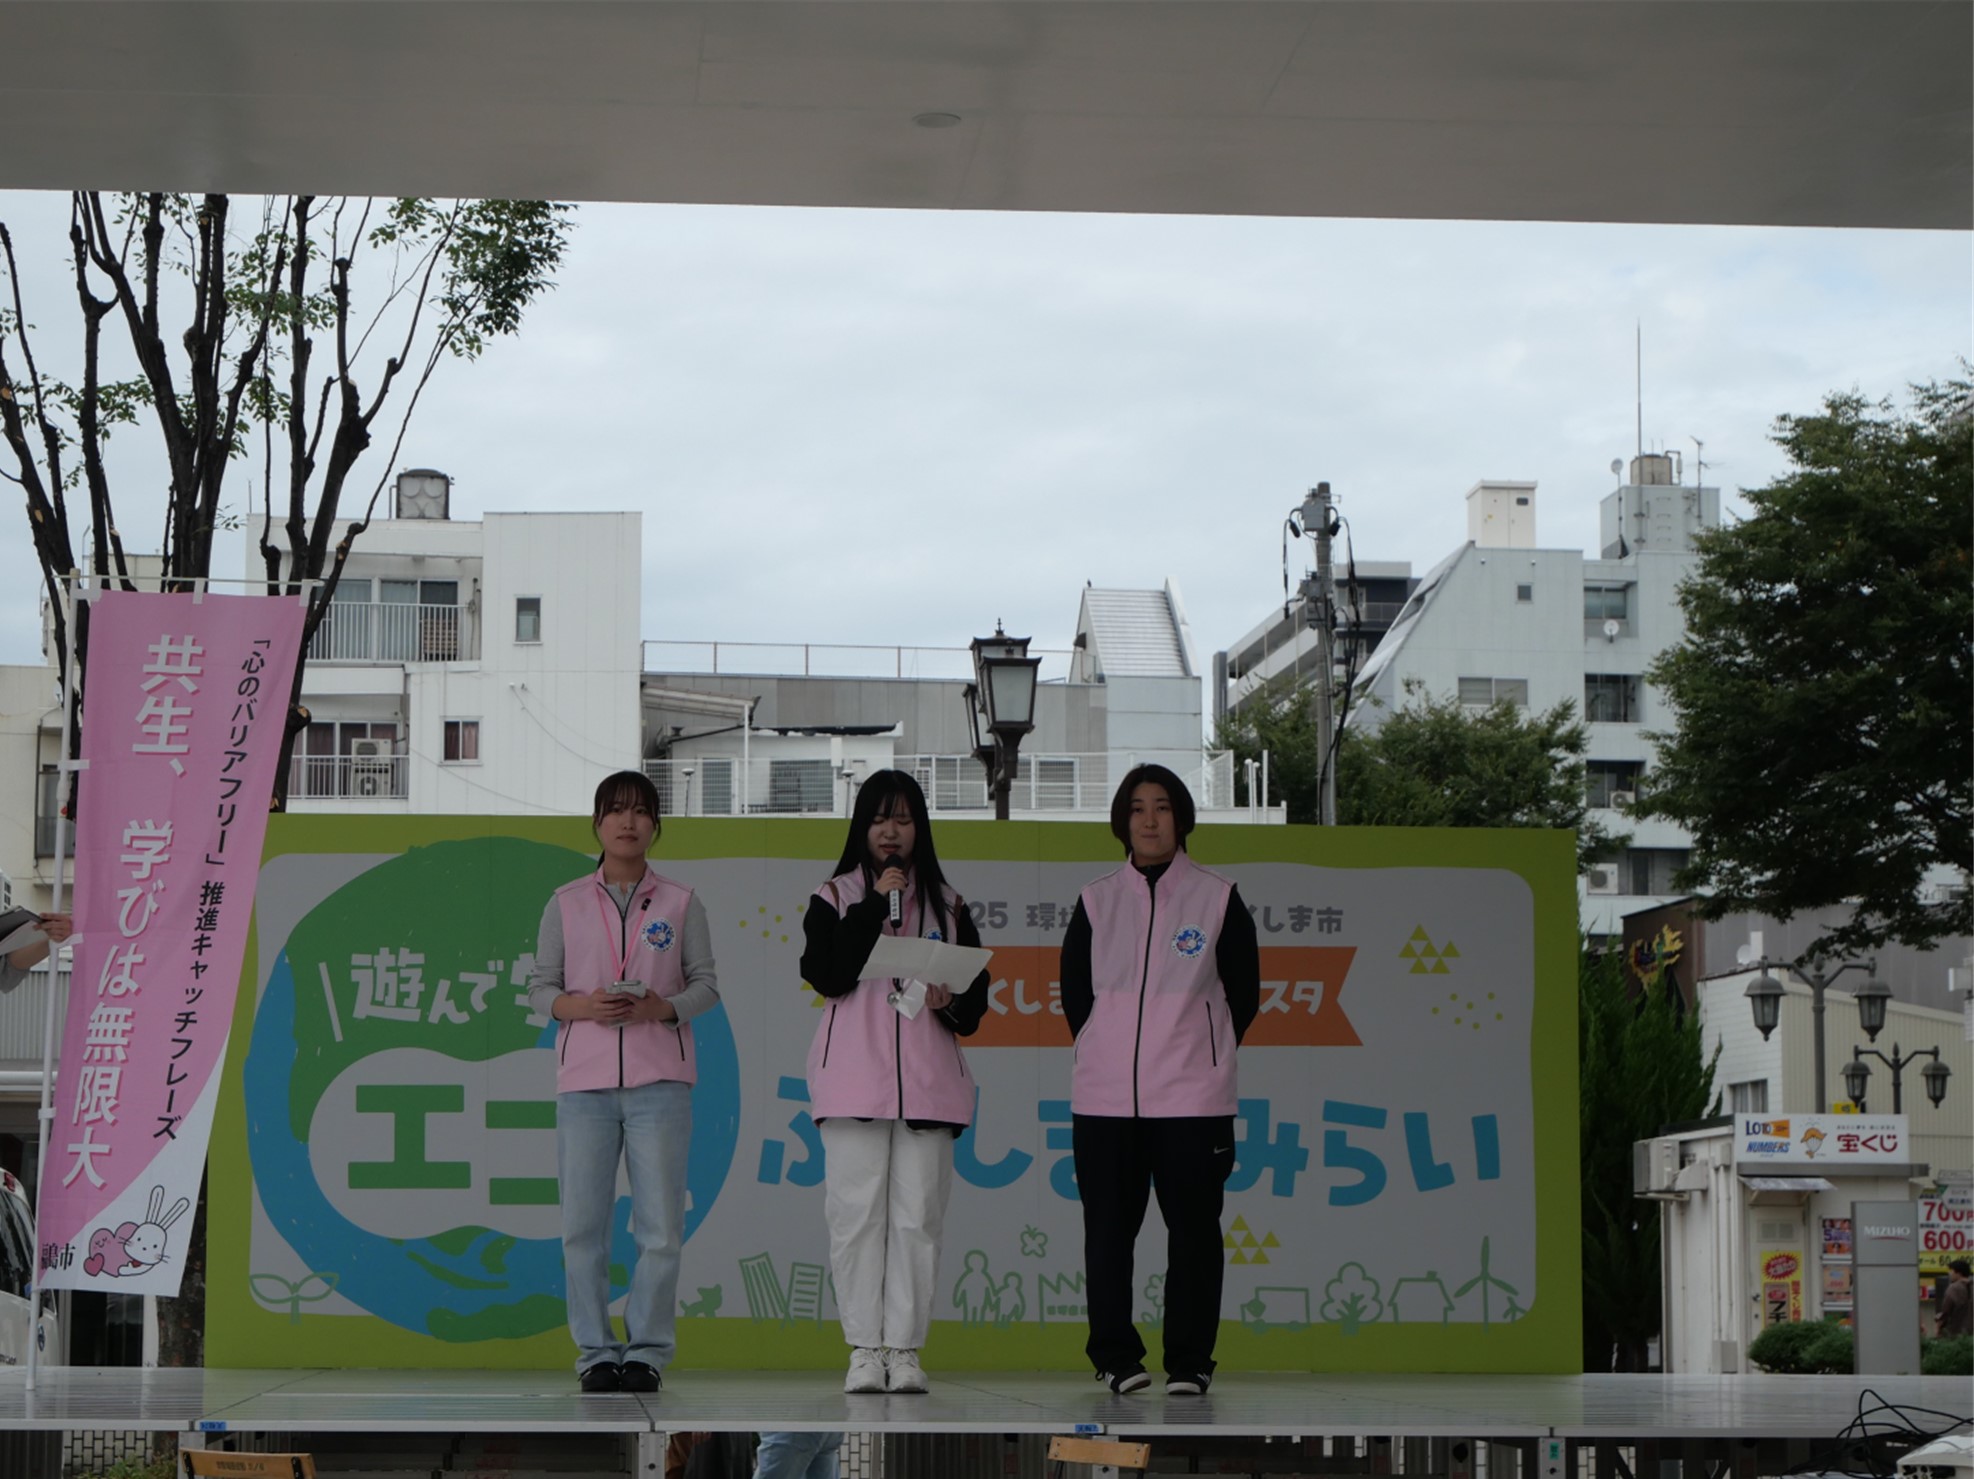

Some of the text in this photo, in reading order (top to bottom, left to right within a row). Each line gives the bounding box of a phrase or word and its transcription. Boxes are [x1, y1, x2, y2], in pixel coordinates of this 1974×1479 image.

[969, 901, 1008, 929] 25
[1026, 902, 1075, 931] 環
[1260, 980, 1324, 1015] スタ
[1746, 1141, 1790, 1153] NUMBERS
[1837, 1133, 1898, 1153] 宝くじ
[1863, 1226, 1911, 1236] MIZUHO
